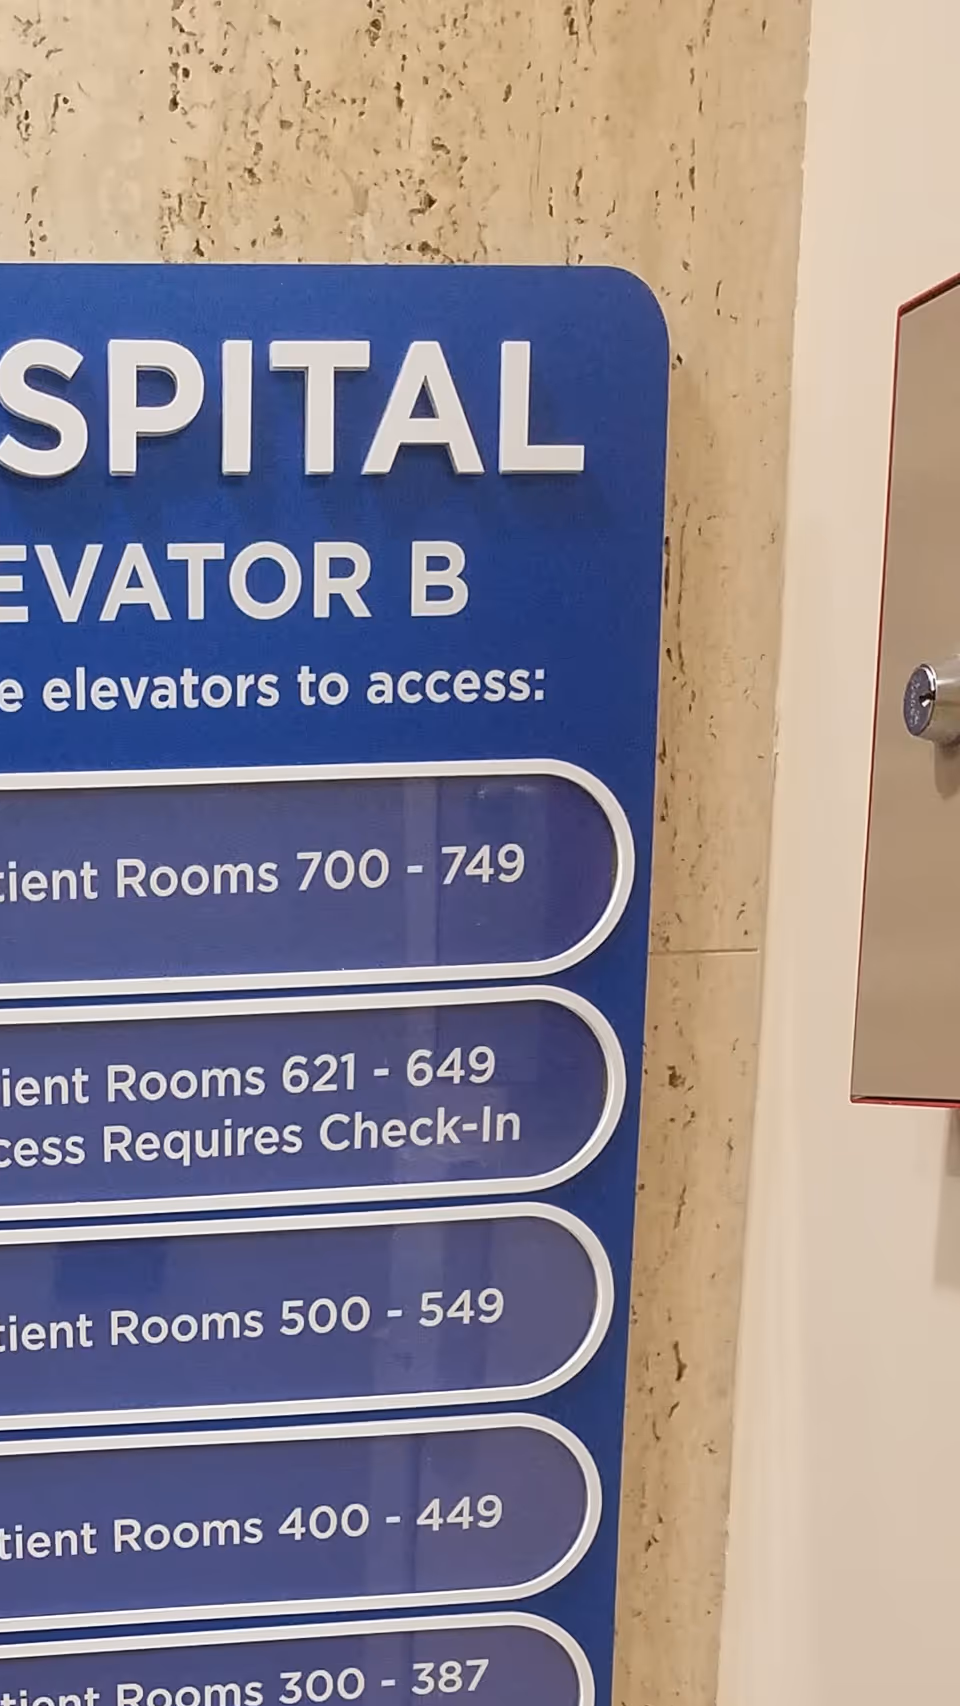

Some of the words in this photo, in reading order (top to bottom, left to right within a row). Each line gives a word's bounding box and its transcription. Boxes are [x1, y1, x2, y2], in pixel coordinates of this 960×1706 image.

[411, 541, 468, 616] B
[43, 667, 279, 711] elevators
[298, 666, 348, 705] to
[367, 669, 544, 704] access:
[116, 858, 279, 898] Rooms
[297, 849, 389, 890] 700
[407, 865, 422, 873] -
[442, 844, 524, 884] 749
[108, 1065, 265, 1102] Rooms
[283, 1053, 354, 1093] 621
[374, 1068, 389, 1076] -
[407, 1046, 495, 1086] 649
[104, 1119, 302, 1166] Requires
[320, 1106, 520, 1150] Check-In
[111, 1310, 263, 1345] Rooms
[280, 1297, 370, 1335] 500
[419, 1288, 503, 1326] 549
[114, 1518, 262, 1552] Rooms
[279, 1504, 369, 1540] 400
[417, 1495, 502, 1531] 449
[279, 1668, 364, 1704] 300
[412, 1659, 489, 1694] 387
